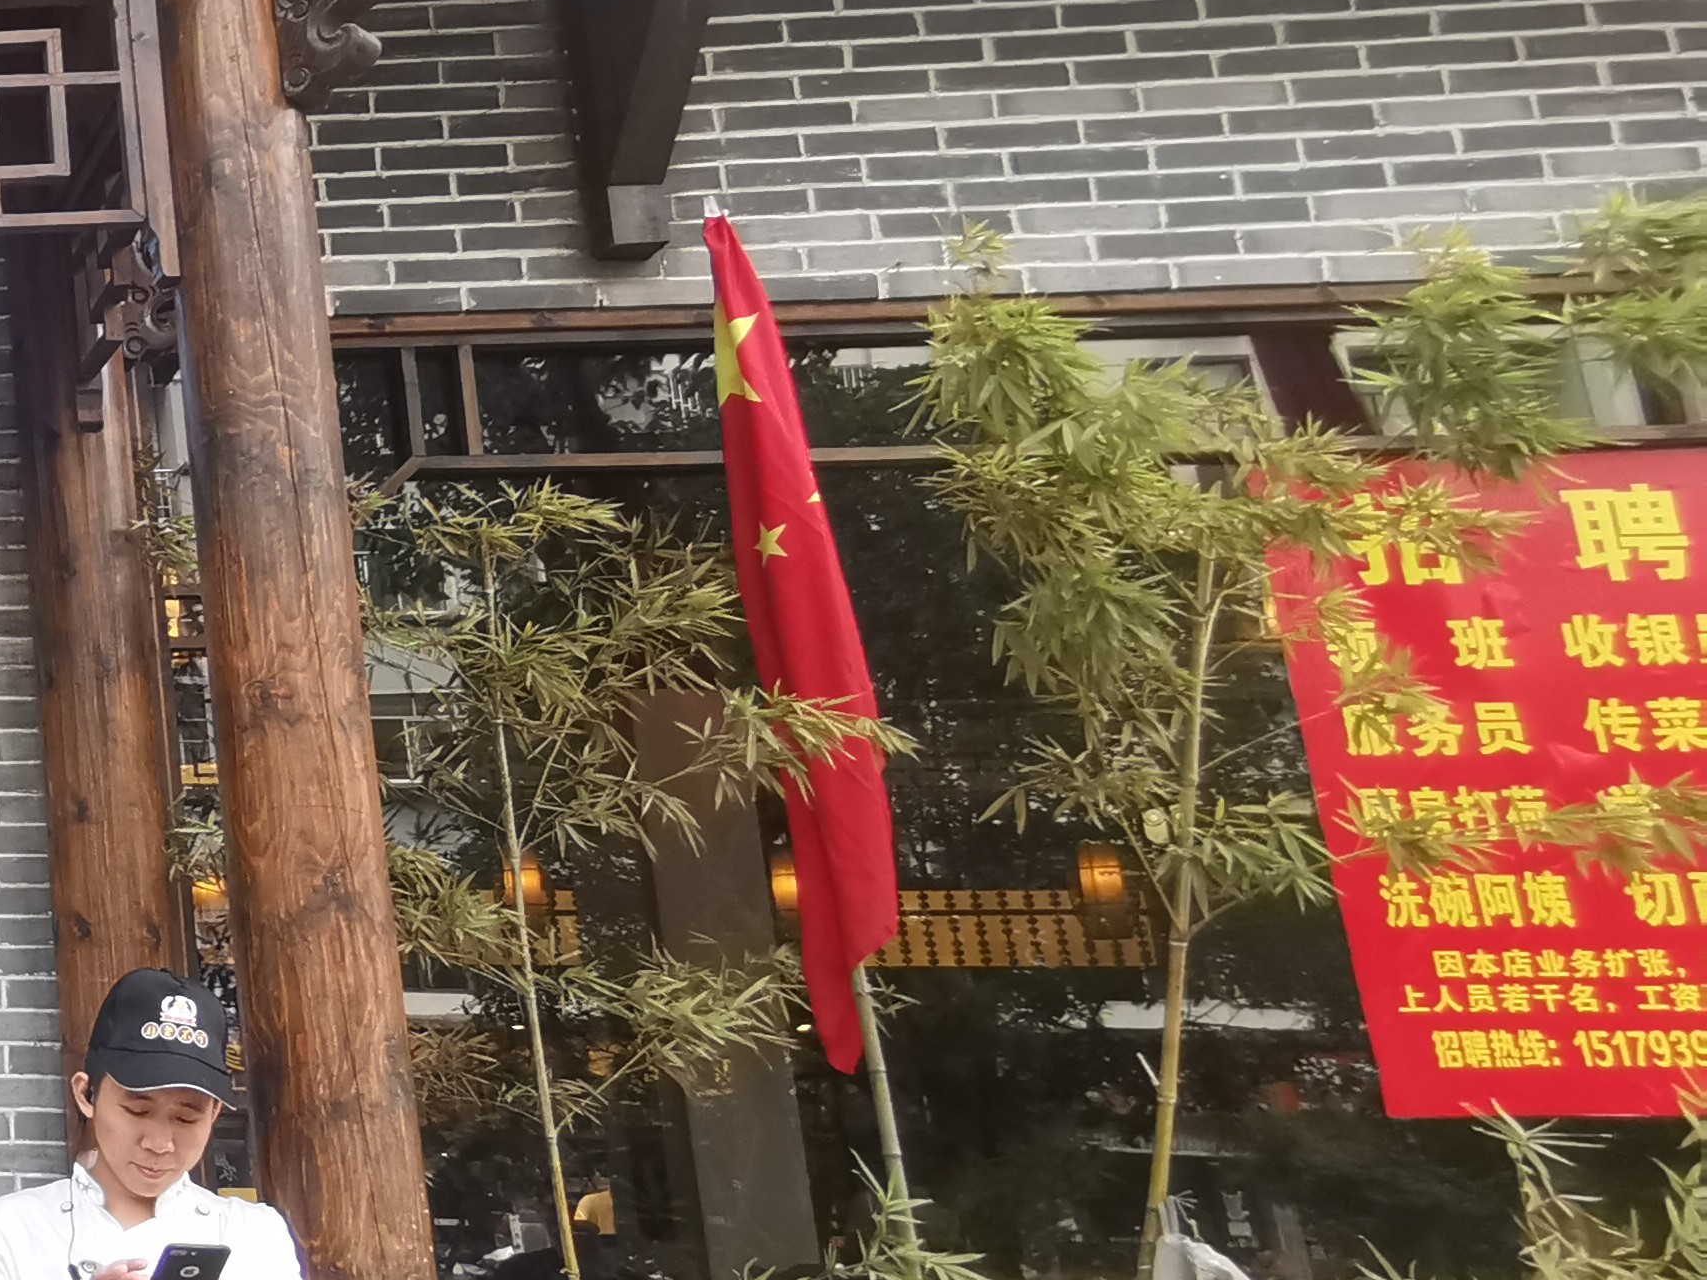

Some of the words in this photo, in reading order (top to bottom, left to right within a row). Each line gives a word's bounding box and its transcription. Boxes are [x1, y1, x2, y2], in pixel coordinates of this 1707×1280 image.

[1378, 871, 1576, 928] 洗碗阿姨
[1398, 983, 1707, 1013] 上人员若干名，工资
